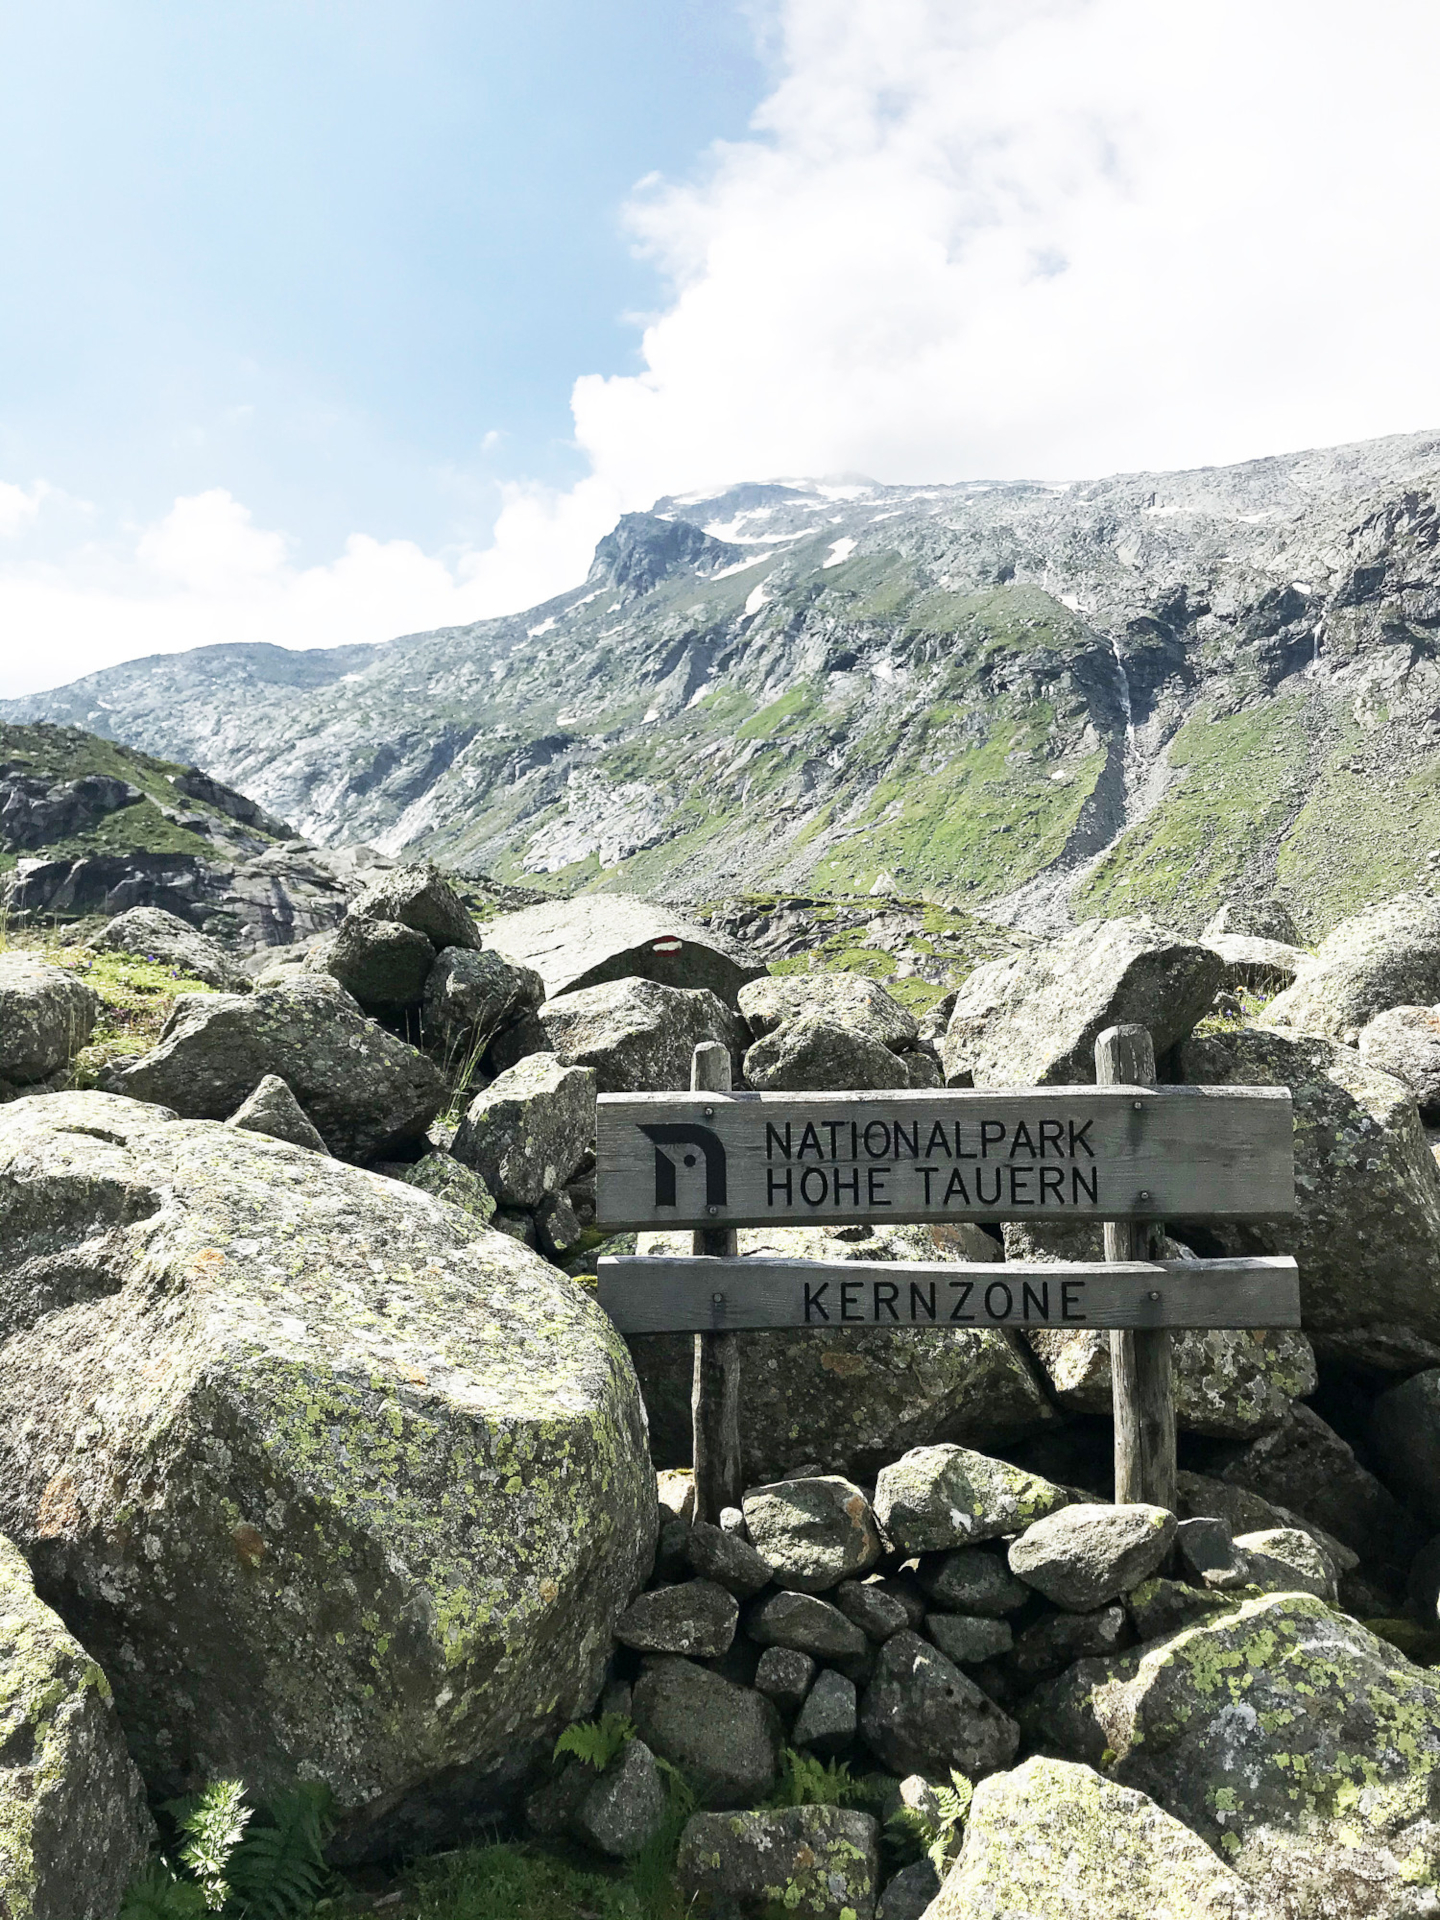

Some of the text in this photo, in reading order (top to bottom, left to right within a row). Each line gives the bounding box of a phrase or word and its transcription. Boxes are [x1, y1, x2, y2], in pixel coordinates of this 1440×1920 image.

[765, 1119, 1096, 1160] NATIONALPARK
[766, 1166, 1099, 1206] HOHE TAUERN
[803, 1281, 1087, 1322] KERNZONE
